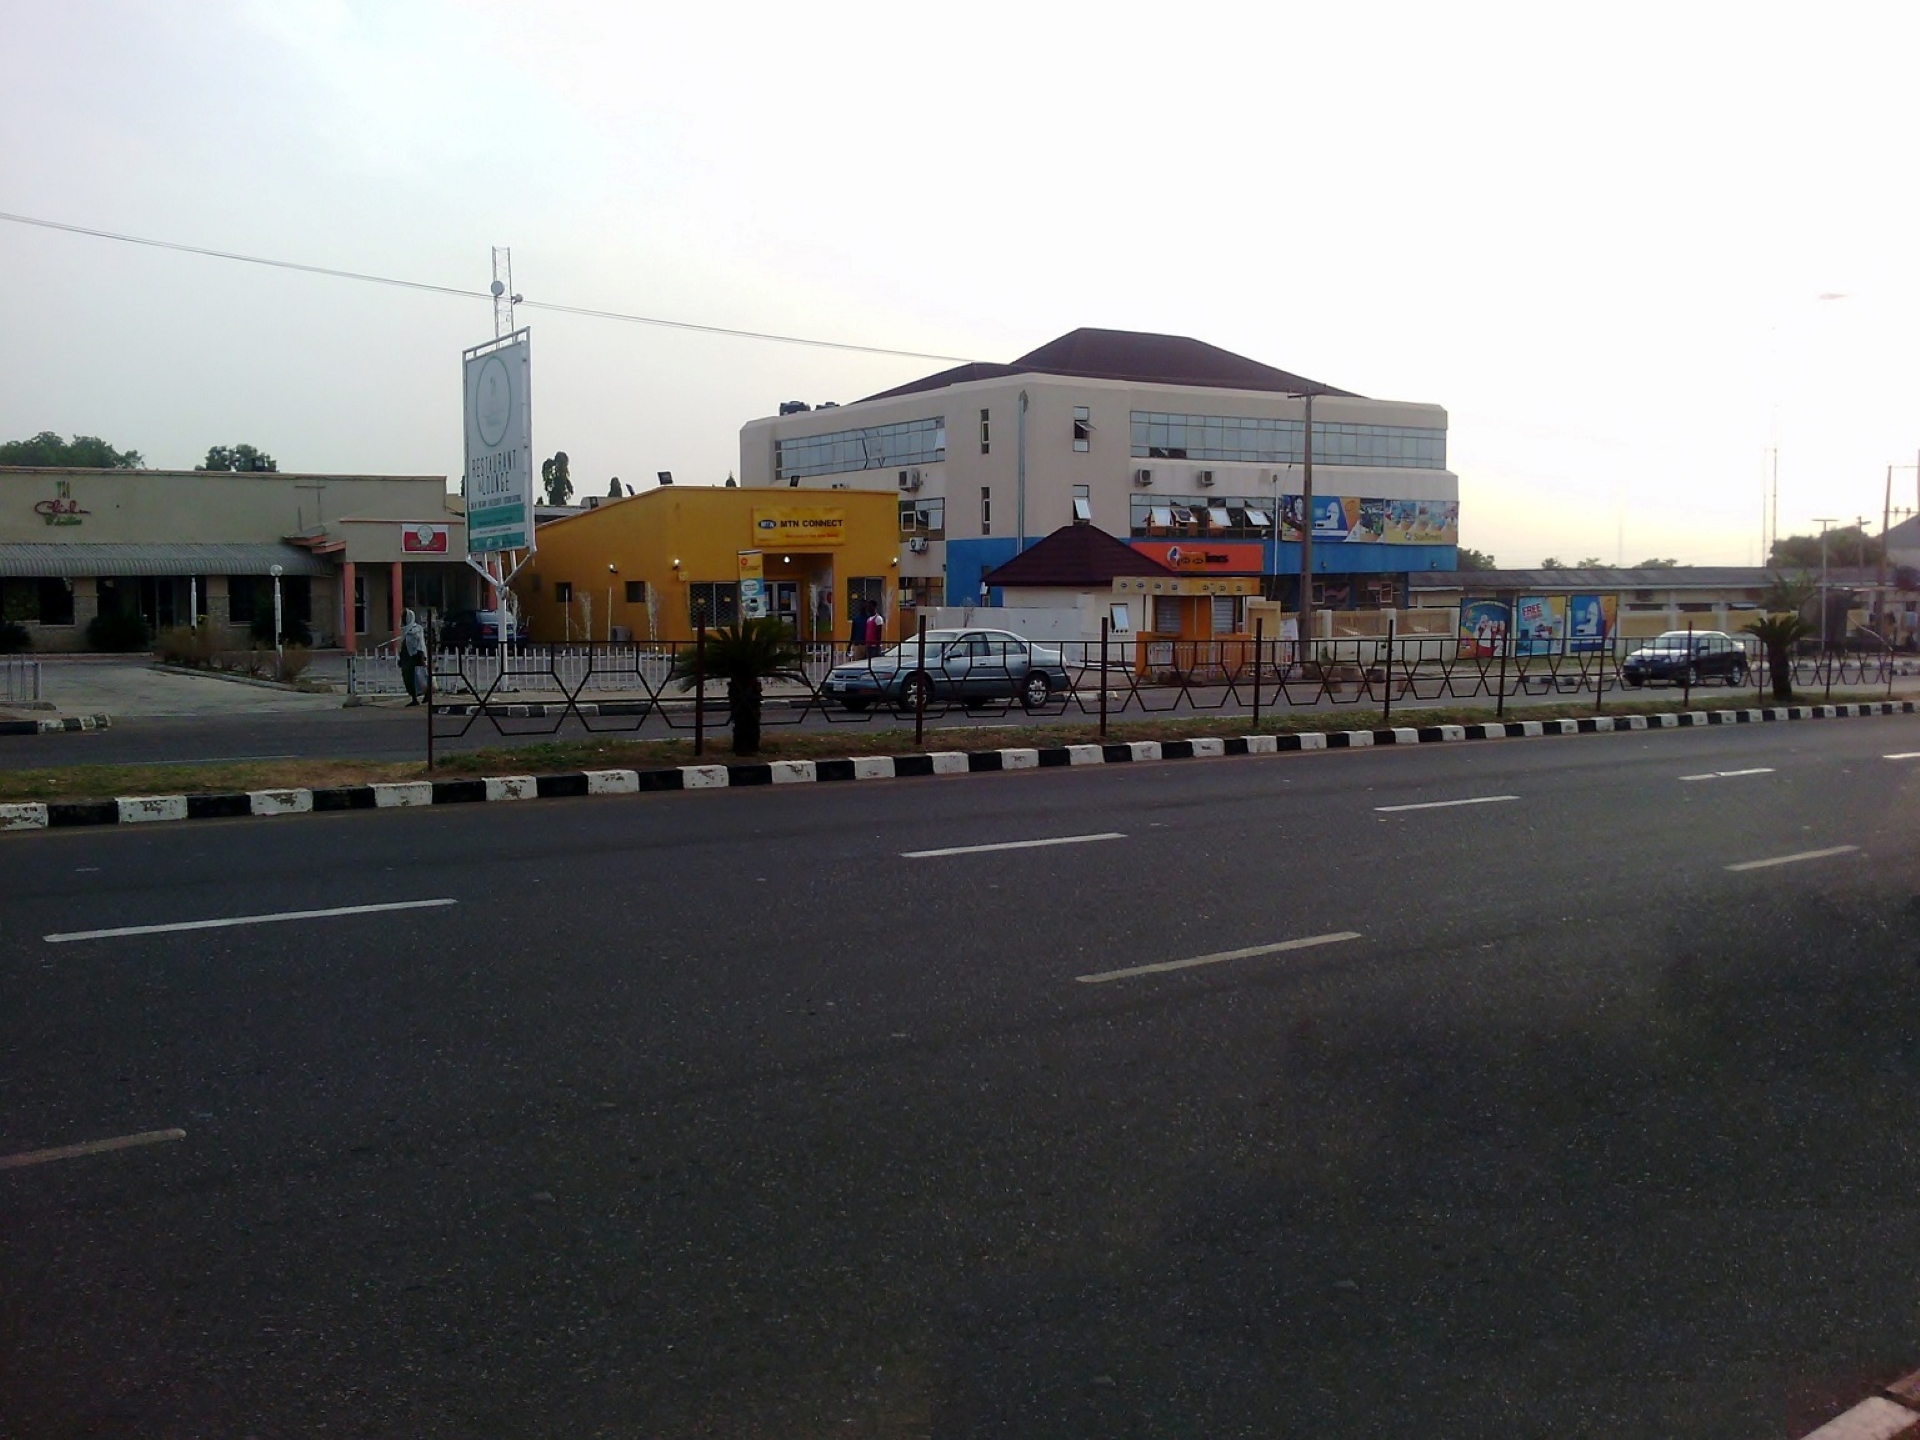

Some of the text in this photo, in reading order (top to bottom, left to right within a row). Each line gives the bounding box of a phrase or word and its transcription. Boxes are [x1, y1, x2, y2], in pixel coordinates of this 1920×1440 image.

[472, 450, 516, 478] RESTAURANT
[780, 519, 843, 528] MTN CONNECT
